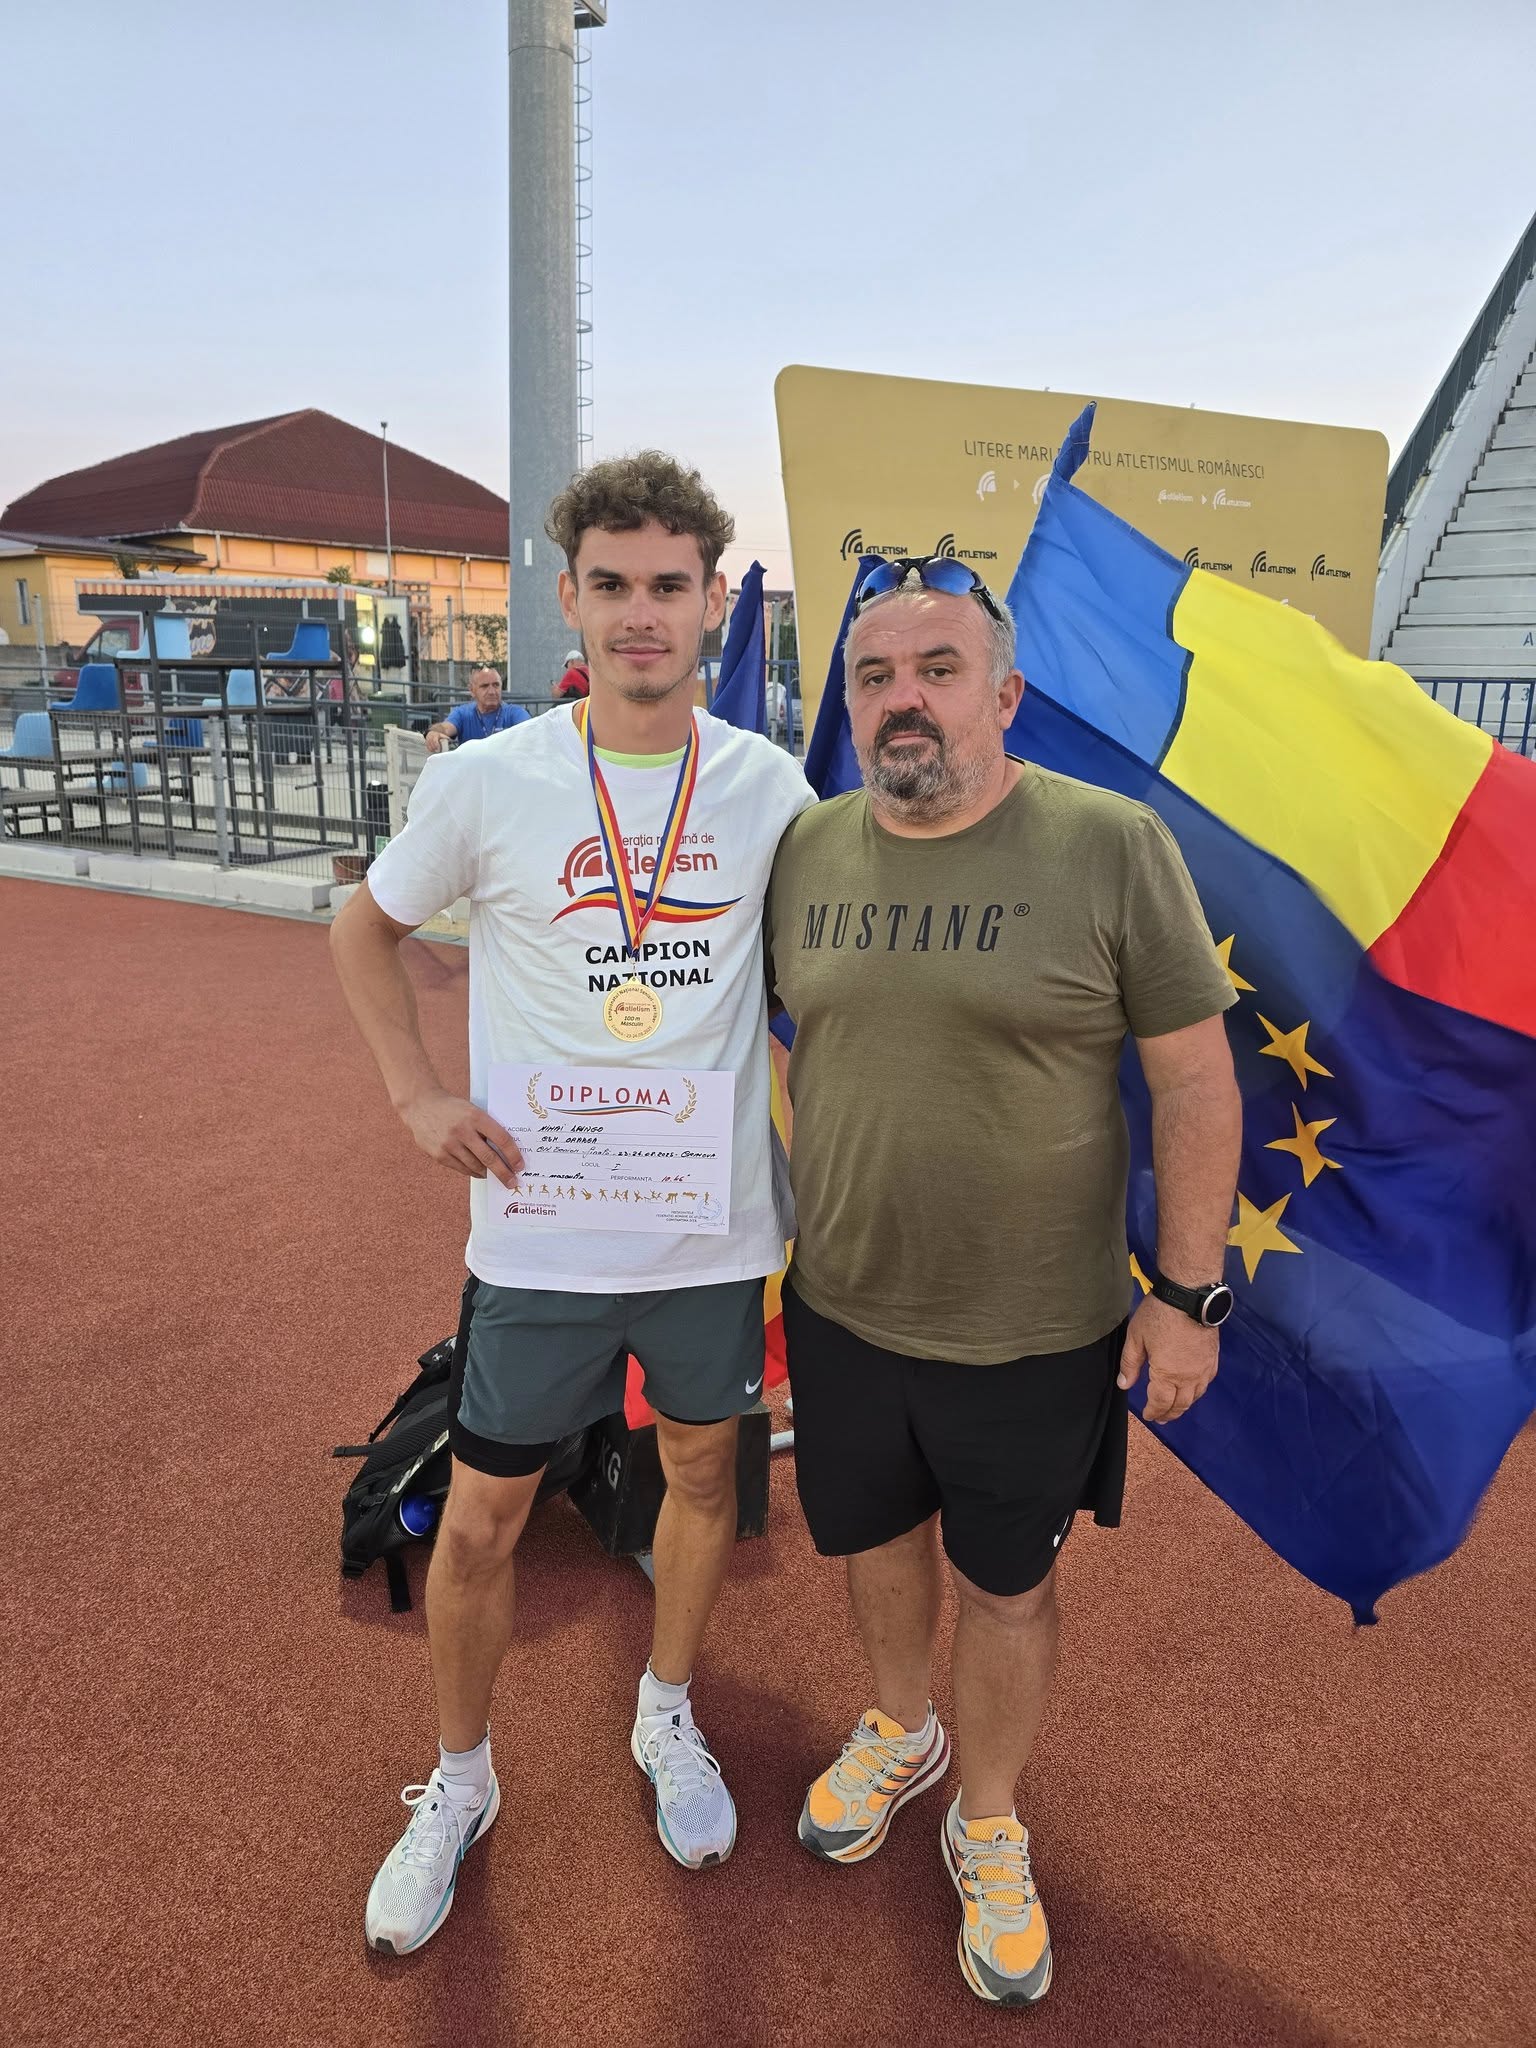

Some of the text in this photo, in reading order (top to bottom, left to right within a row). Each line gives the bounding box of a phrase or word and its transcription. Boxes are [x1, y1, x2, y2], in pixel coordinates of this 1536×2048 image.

[963, 439, 1013, 459] LITERE
[1018, 444, 1053, 462] MARI
[1116, 453, 1194, 473] ATLETISMUL
[866, 545, 908, 556] ATLETISM
[957, 550, 998, 560] ATLETISM
[1200, 562, 1233, 572] ATLETISM
[1267, 567, 1297, 575] ATLETISM
[1325, 568, 1351, 579] ATLETISM
[700, 832, 715, 844] de
[550, 1084, 671, 1106] DIPLOMA
[519, 1206, 557, 1216] atletism
